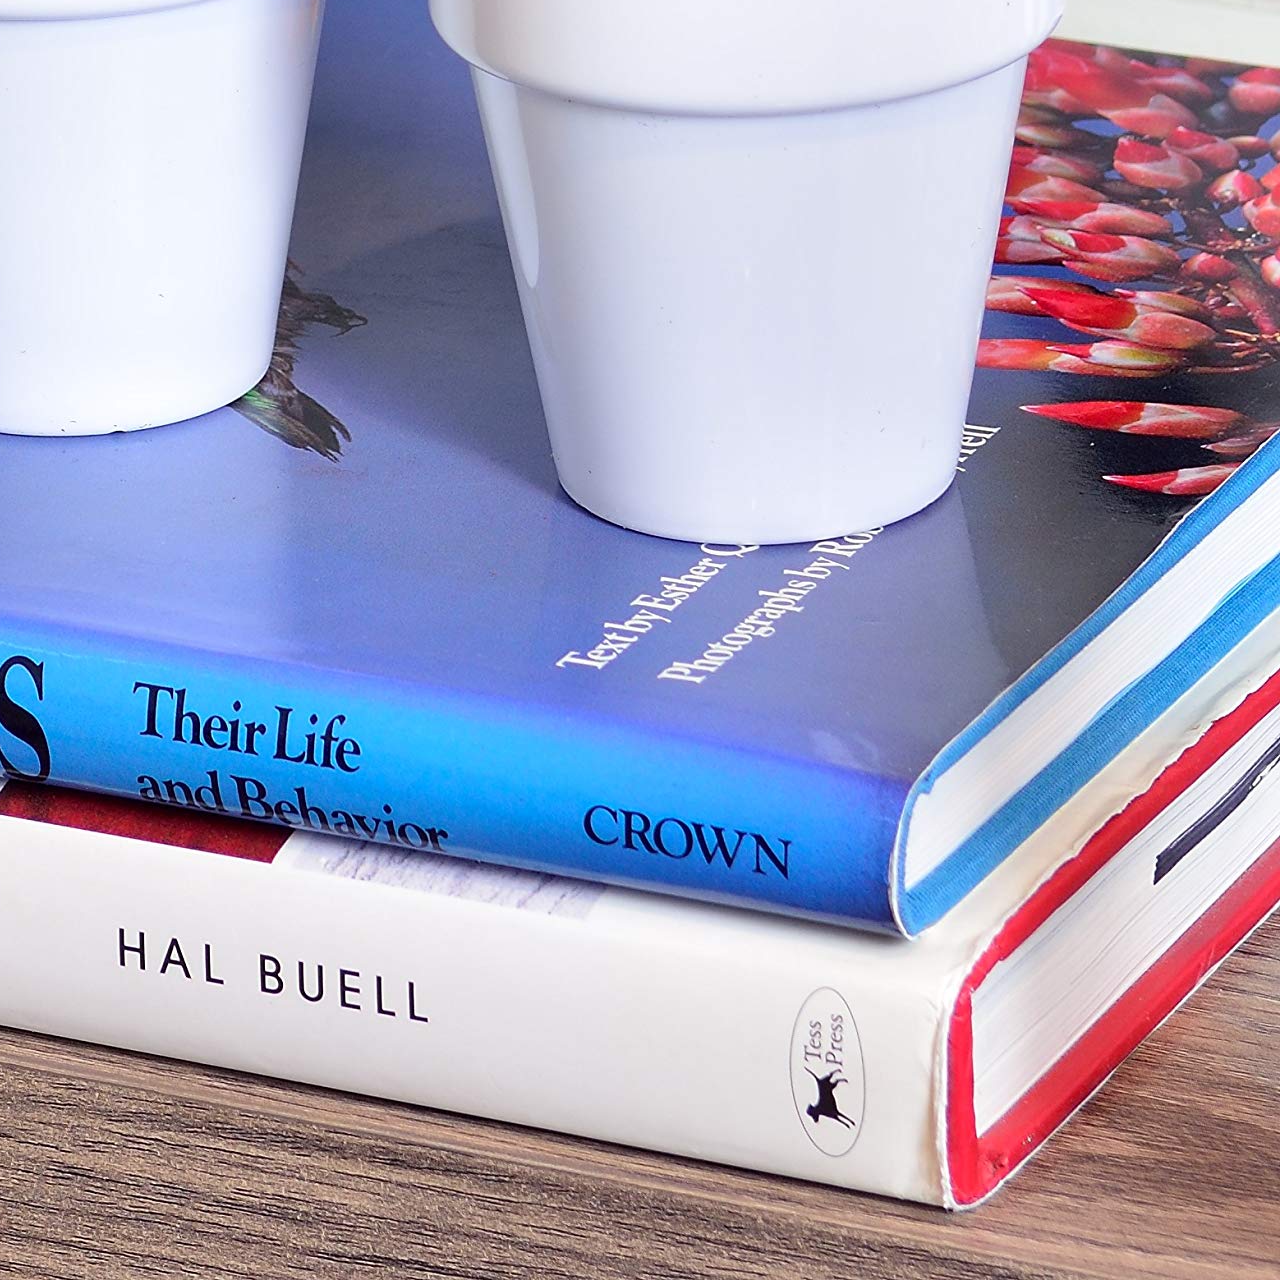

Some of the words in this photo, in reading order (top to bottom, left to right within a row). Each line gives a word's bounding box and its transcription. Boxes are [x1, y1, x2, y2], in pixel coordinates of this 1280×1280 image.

[630, 558, 727, 612] Esther
[556, 631, 638, 670] Text
[604, 609, 672, 634] by
[657, 579, 817, 684] Photographs
[784, 556, 850, 580] by
[133, 681, 267, 756] Their
[273, 705, 361, 773] Life
[137, 770, 228, 813] and
[230, 774, 449, 852] Behavior
[583, 805, 792, 880] CROWN
[118, 927, 225, 985] HAL
[259, 953, 429, 1023] BUELL
[803, 1020, 822, 1062] Tess
[825, 1014, 844, 1066] Press
